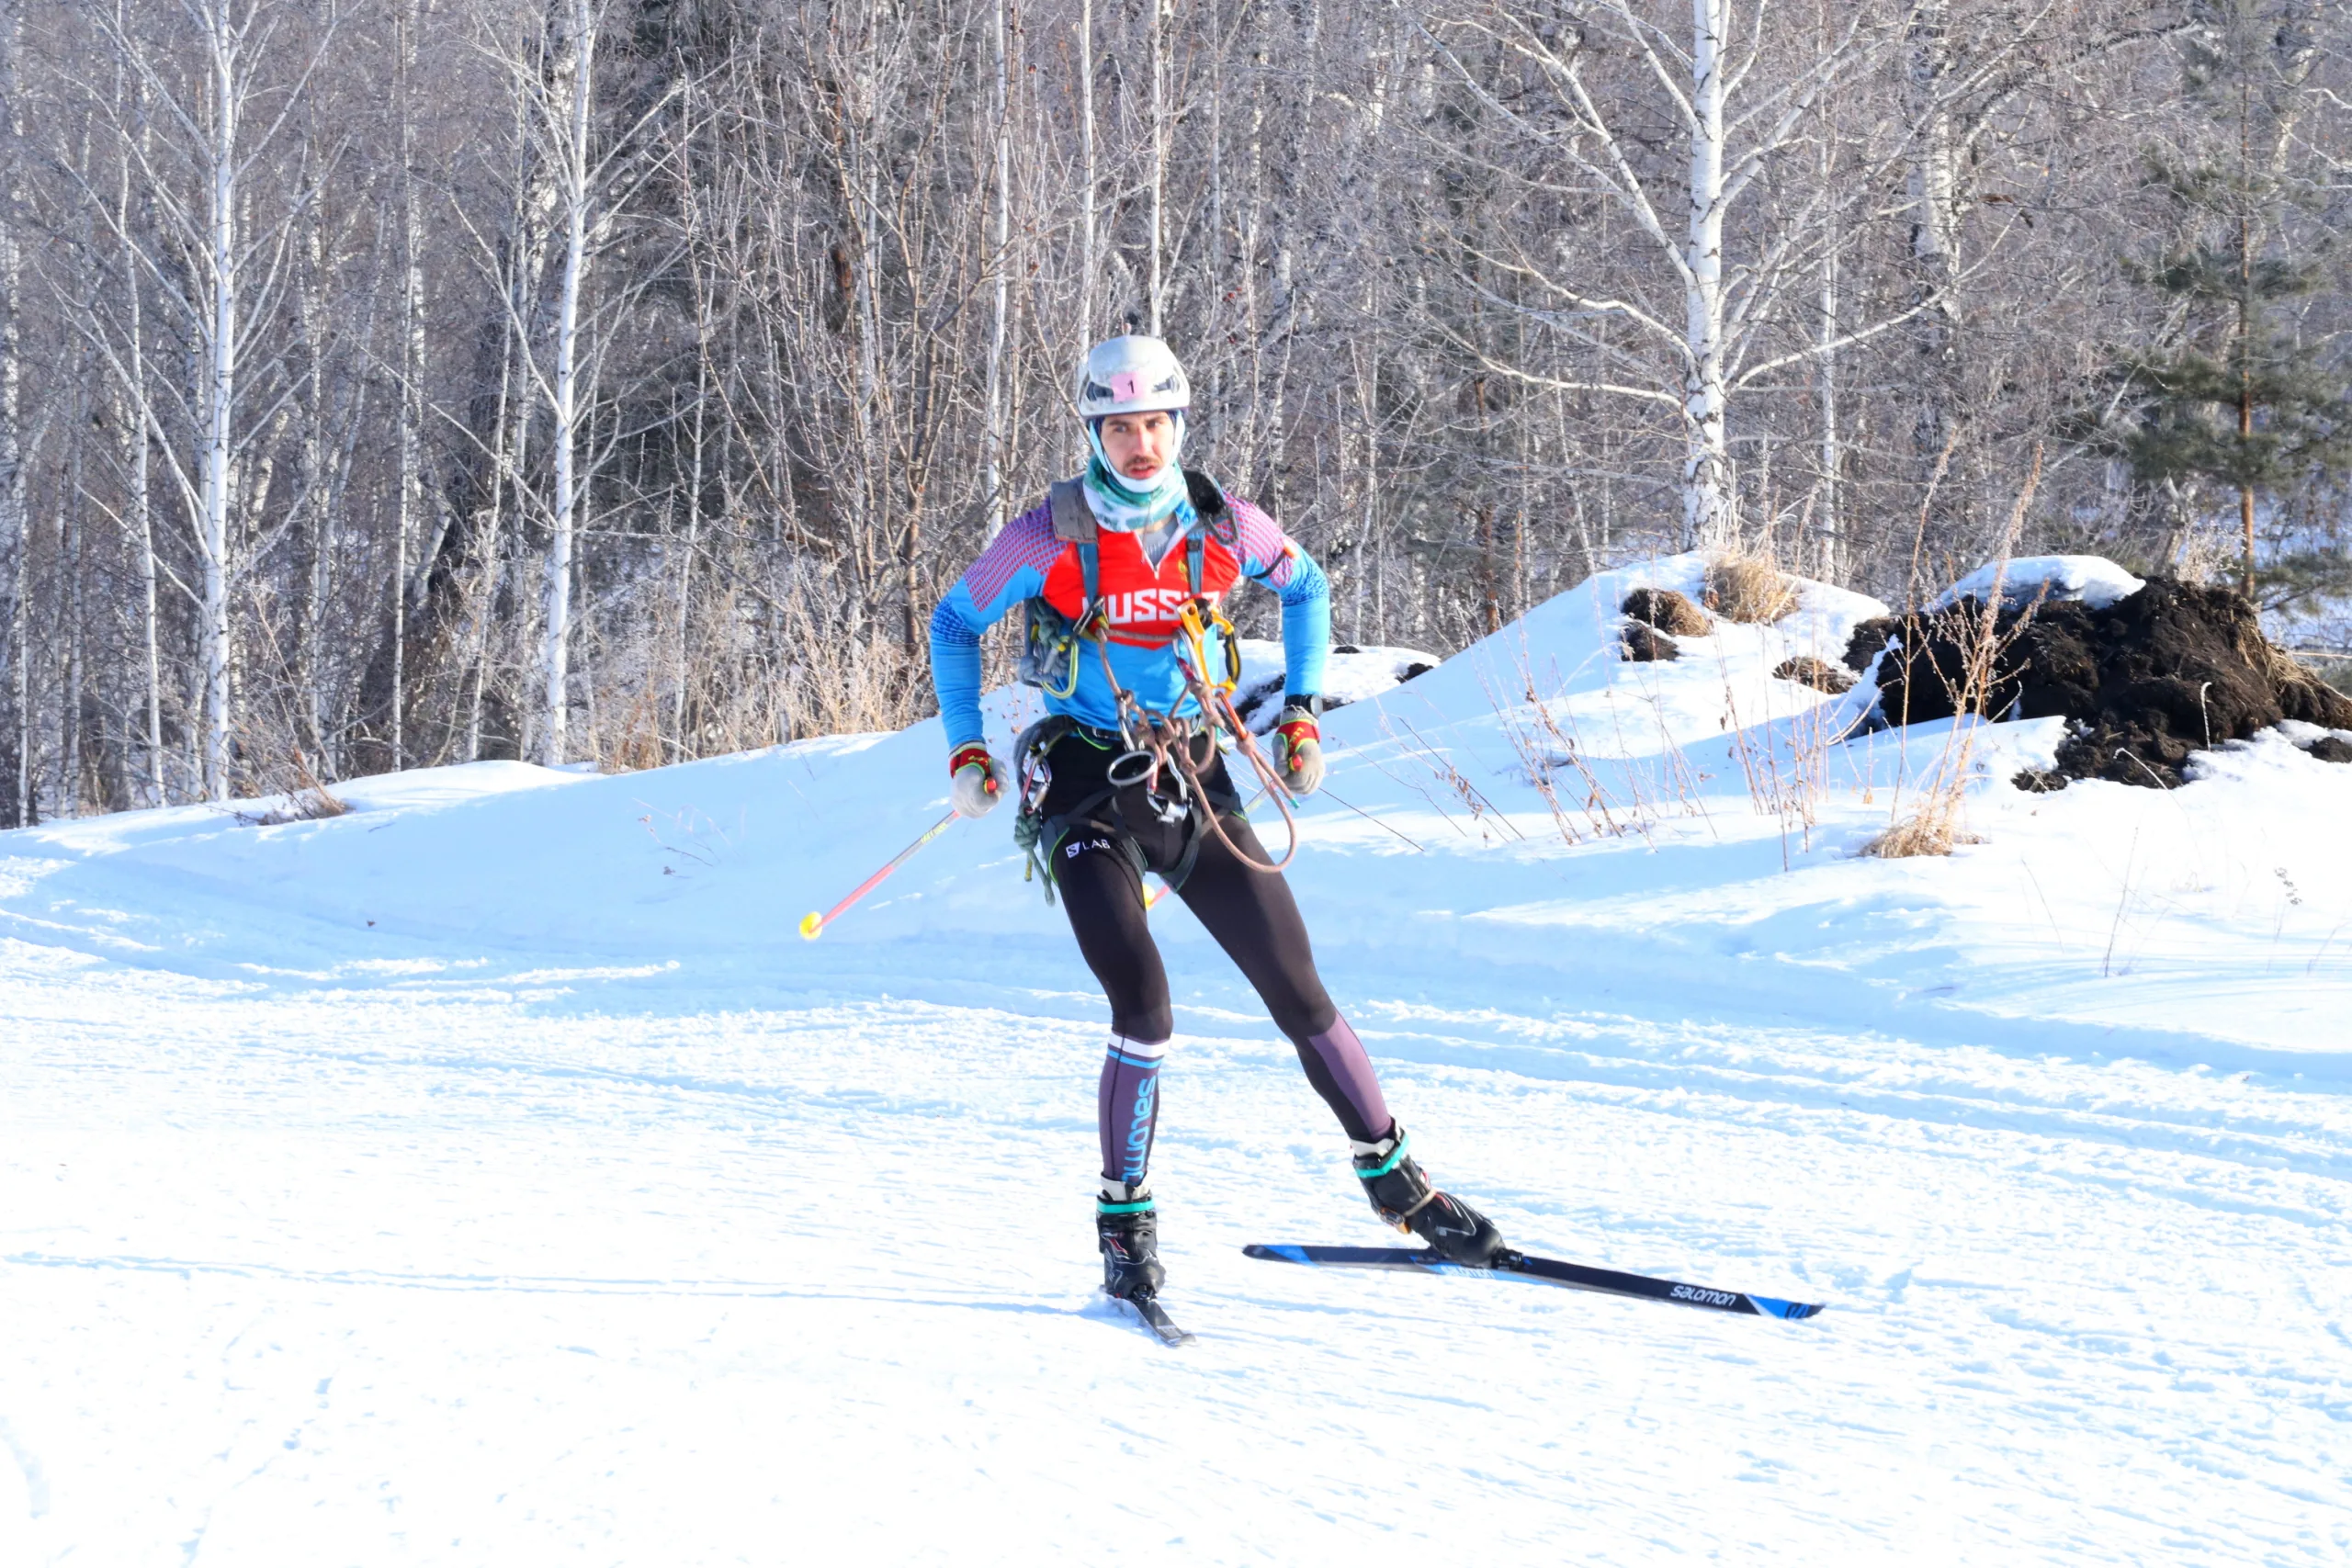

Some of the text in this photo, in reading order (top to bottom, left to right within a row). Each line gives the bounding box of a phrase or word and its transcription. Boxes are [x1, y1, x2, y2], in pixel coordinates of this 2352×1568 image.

[1127, 379, 1135, 394] 1
[1082, 588, 1220, 625] USS
[1081, 839, 1111, 851] LAB
[1670, 1285, 1736, 1306] salomon
